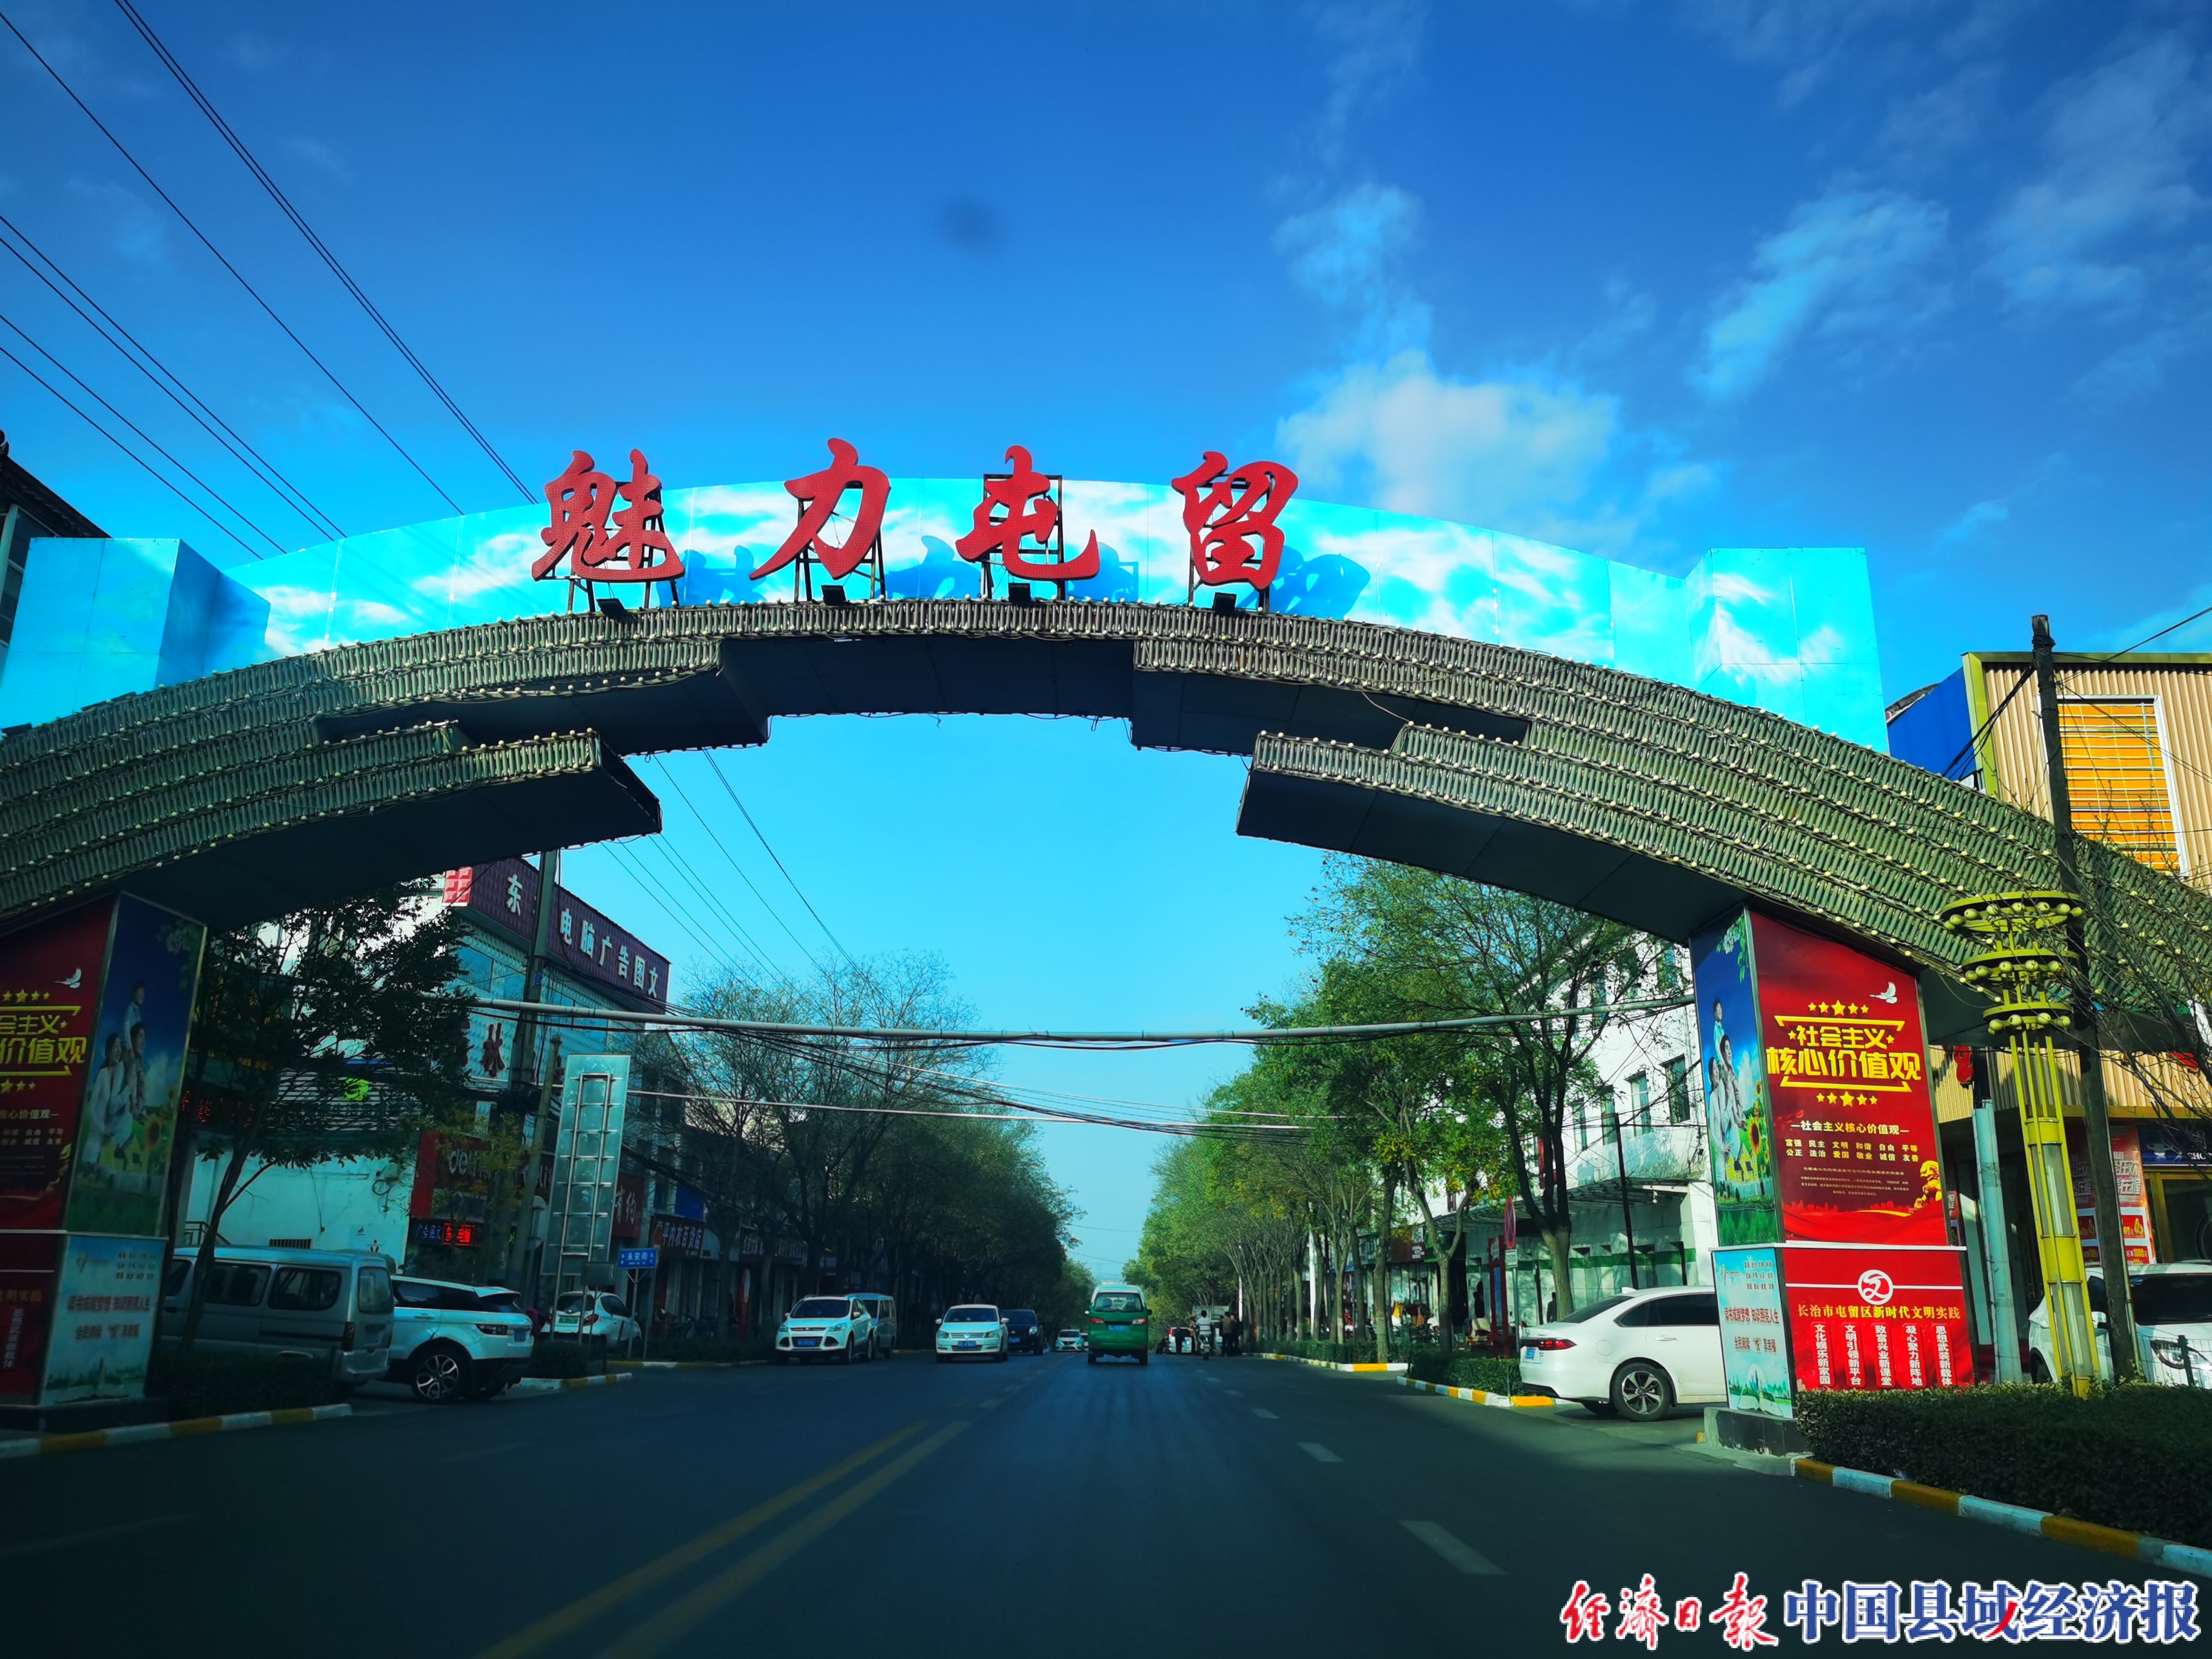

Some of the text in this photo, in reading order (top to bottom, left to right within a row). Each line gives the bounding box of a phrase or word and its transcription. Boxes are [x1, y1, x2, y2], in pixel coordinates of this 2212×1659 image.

[531, 437, 1298, 591] 魅力屯留
[506, 874, 659, 998] 东电脑广告图文
[1796, 1025, 1887, 1050] 社会主义
[1766, 1046, 1922, 1081] 核心价值观
[1785, 1138, 1918, 1153] 富强 民主 文明 和谐 自由 平等
[1800, 1120, 1900, 1135] 社会主义核心价值观
[1809, 1150, 1826, 1158] 法治
[1832, 1150, 1849, 1159] 爱国
[1856, 1151, 1873, 1160] 敬业
[1797, 1304, 1961, 1319] 长治市屯留区新时代文明实践
[1814, 1324, 1831, 1385] 文化娱乐新家园
[1844, 1324, 1862, 1386] 文明引领新平台
[1874, 1325, 1892, 1387] 致富兴业新课堂
[1905, 1325, 1923, 1387] 凝心聚力新阵地
